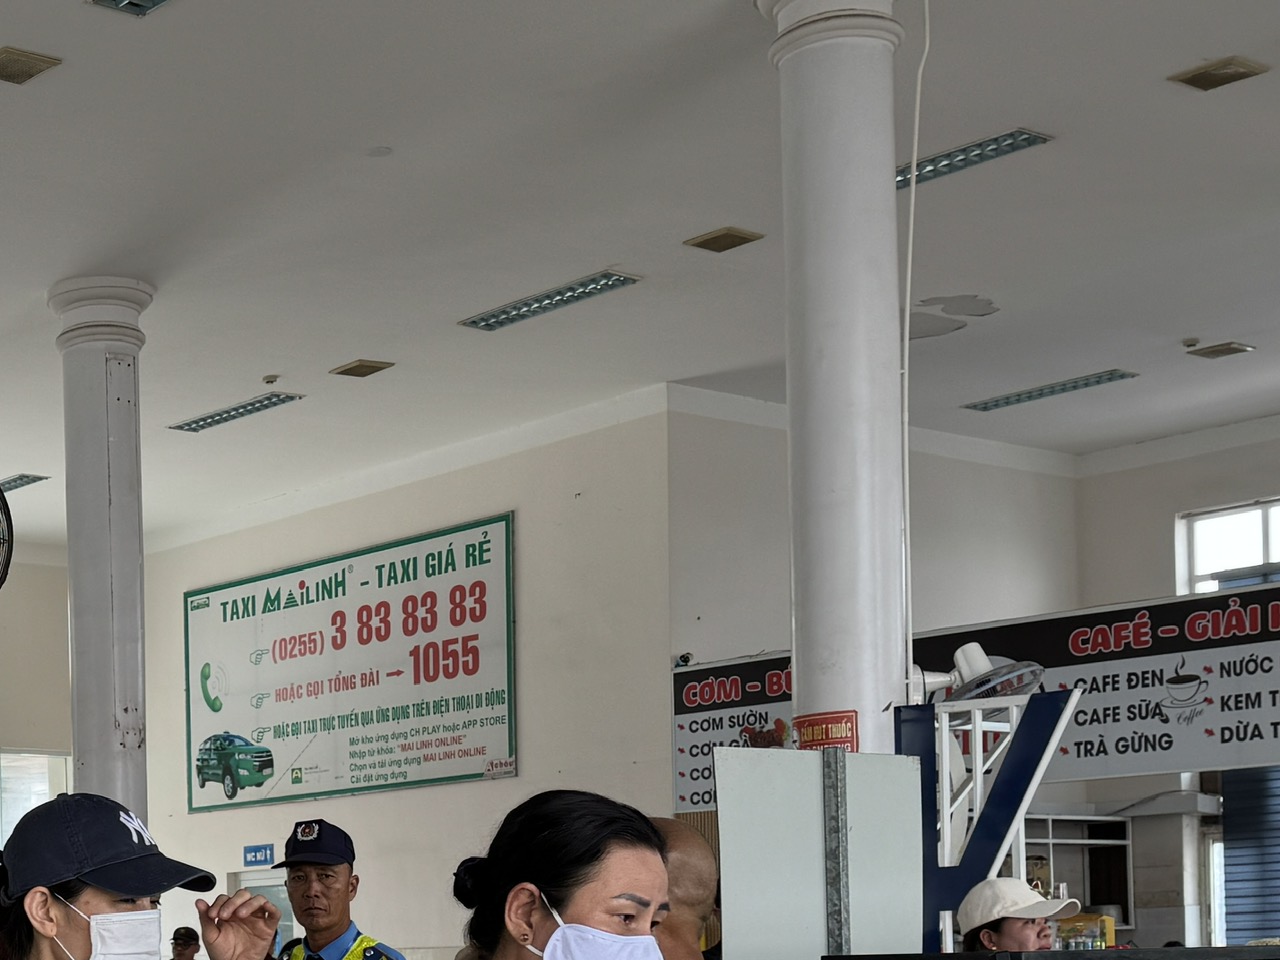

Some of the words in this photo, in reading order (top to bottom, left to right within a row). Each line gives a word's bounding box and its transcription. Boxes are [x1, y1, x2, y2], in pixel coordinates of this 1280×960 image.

[221, 595, 256, 622] TAXI
[375, 557, 418, 588] TAXI
[425, 542, 456, 578] GIÁ
[465, 531, 491, 568] RẺ
[272, 631, 324, 664] (0255)
[331, 610, 346, 650] 3
[357, 601, 391, 646] 83
[402, 591, 438, 637] 83
[449, 580, 487, 627] 83
[1069, 611, 1152, 656] CAFÉ
[1185, 597, 1261, 641] GIẢI
[306, 680, 324, 699] GỌI
[328, 670, 356, 693] TỔNG
[360, 668, 380, 688] ĐÀI
[409, 634, 480, 685] 1055
[1220, 653, 1274, 679] NƯỚC
[683, 675, 741, 707] CƠM
[1074, 674, 1120, 696] CAFE
[1127, 668, 1164, 690] ĐEN
[303, 719, 318, 734] TAXI
[361, 710, 374, 727] QUA
[475, 693, 483, 709] DI
[1074, 706, 1121, 727] CAFE
[1127, 699, 1165, 721] SỮA
[1220, 691, 1262, 712] KEM
[409, 726, 420, 737] CH
[421, 725, 441, 736] PLAY
[461, 719, 478, 730] APP
[480, 715, 507, 728] STORE
[689, 716, 723, 733] CƠM
[728, 709, 769, 729] SƯỜN
[1177, 708, 1204, 726] Coffee
[416, 739, 433, 751] LINH
[1074, 734, 1109, 759] TRÀ
[1115, 731, 1174, 755] GỪNG
[1220, 720, 1264, 744] DỪA
[423, 752, 437, 763] MAI
[438, 750, 456, 761] LINH
[457, 746, 487, 759] ONLINE
[690, 765, 713, 781] CƠ
[690, 789, 716, 805] CƠ
